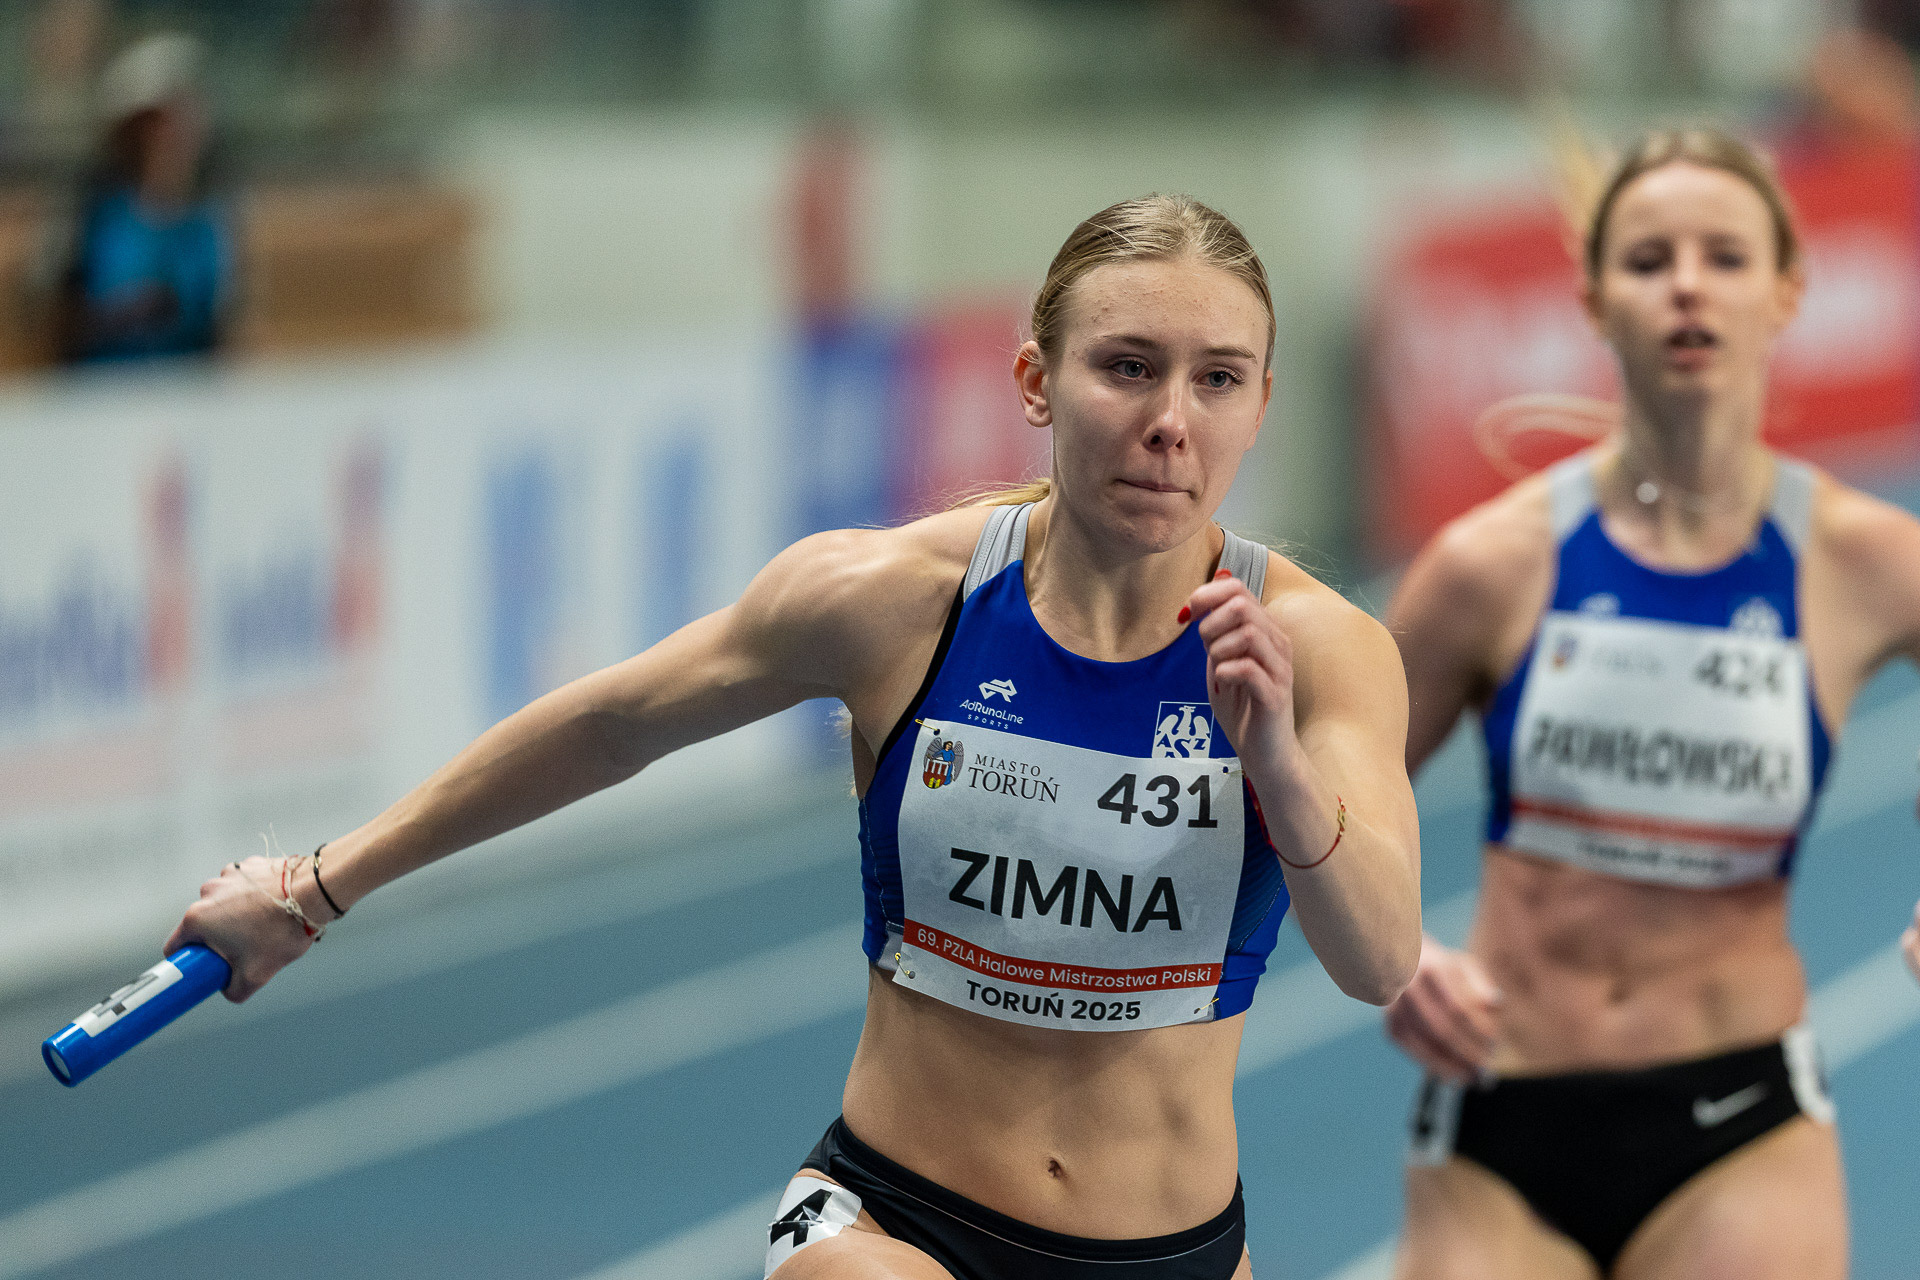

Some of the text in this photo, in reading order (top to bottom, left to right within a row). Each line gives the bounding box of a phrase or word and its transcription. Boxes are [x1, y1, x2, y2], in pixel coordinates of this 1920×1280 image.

[967, 713, 1009, 730] SPORTS
[968, 766, 1061, 804] TORUŃ
[975, 754, 1041, 777] MIASTO
[1097, 773, 1218, 829] 431
[949, 847, 1182, 933] ZIMNA
[917, 928, 1211, 988] 69. PZLA Halowe Mistrzostwa Polski
[966, 979, 1141, 1021] TORUŃ 2025
